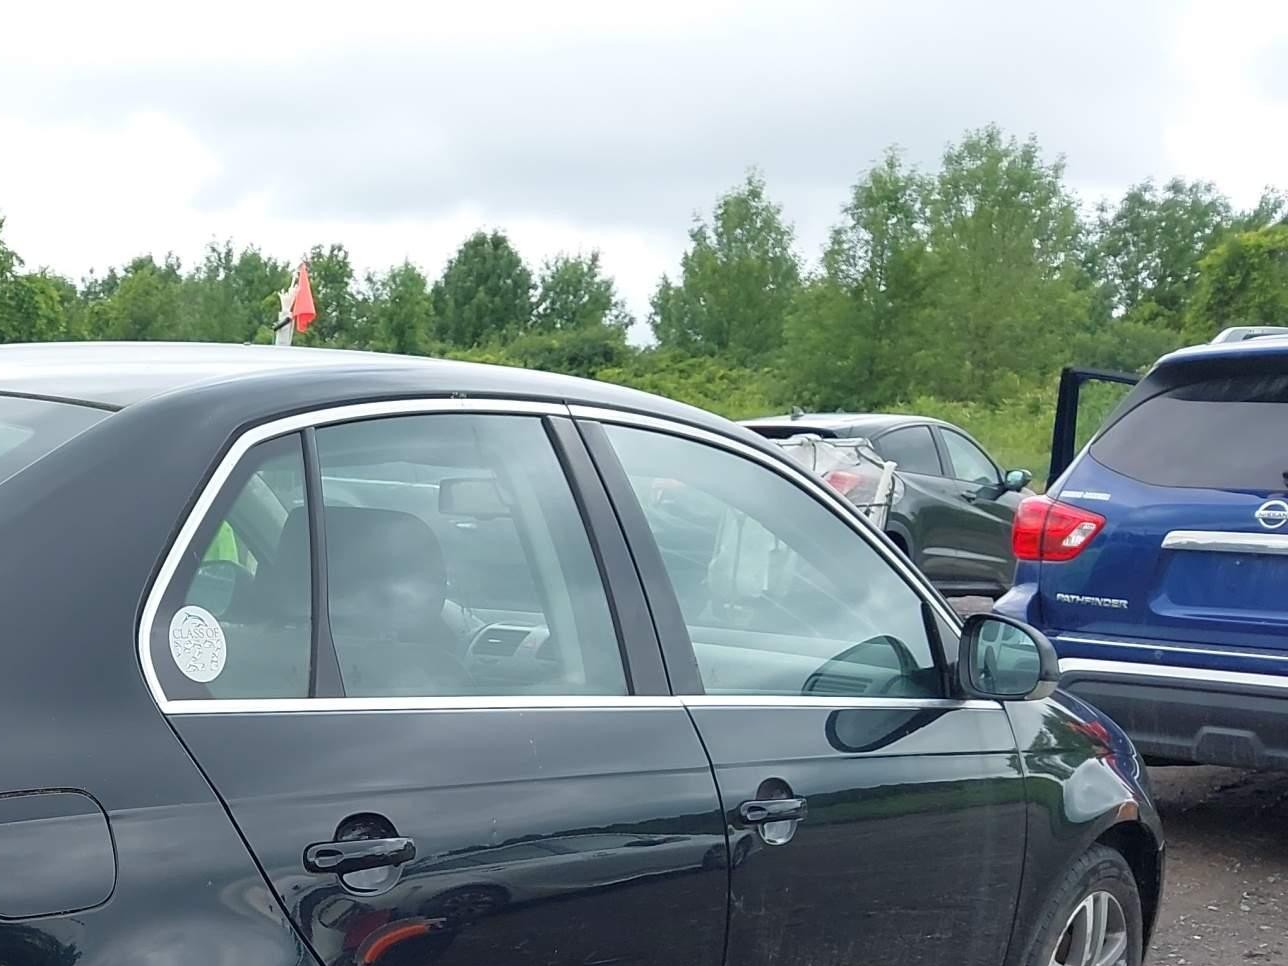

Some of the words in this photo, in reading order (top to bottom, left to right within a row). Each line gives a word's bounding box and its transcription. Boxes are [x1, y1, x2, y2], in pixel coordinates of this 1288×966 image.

[1056, 593, 1129, 609] PATHFINDER
[172, 627, 205, 639] CLASS
[206, 626, 220, 639] OF
